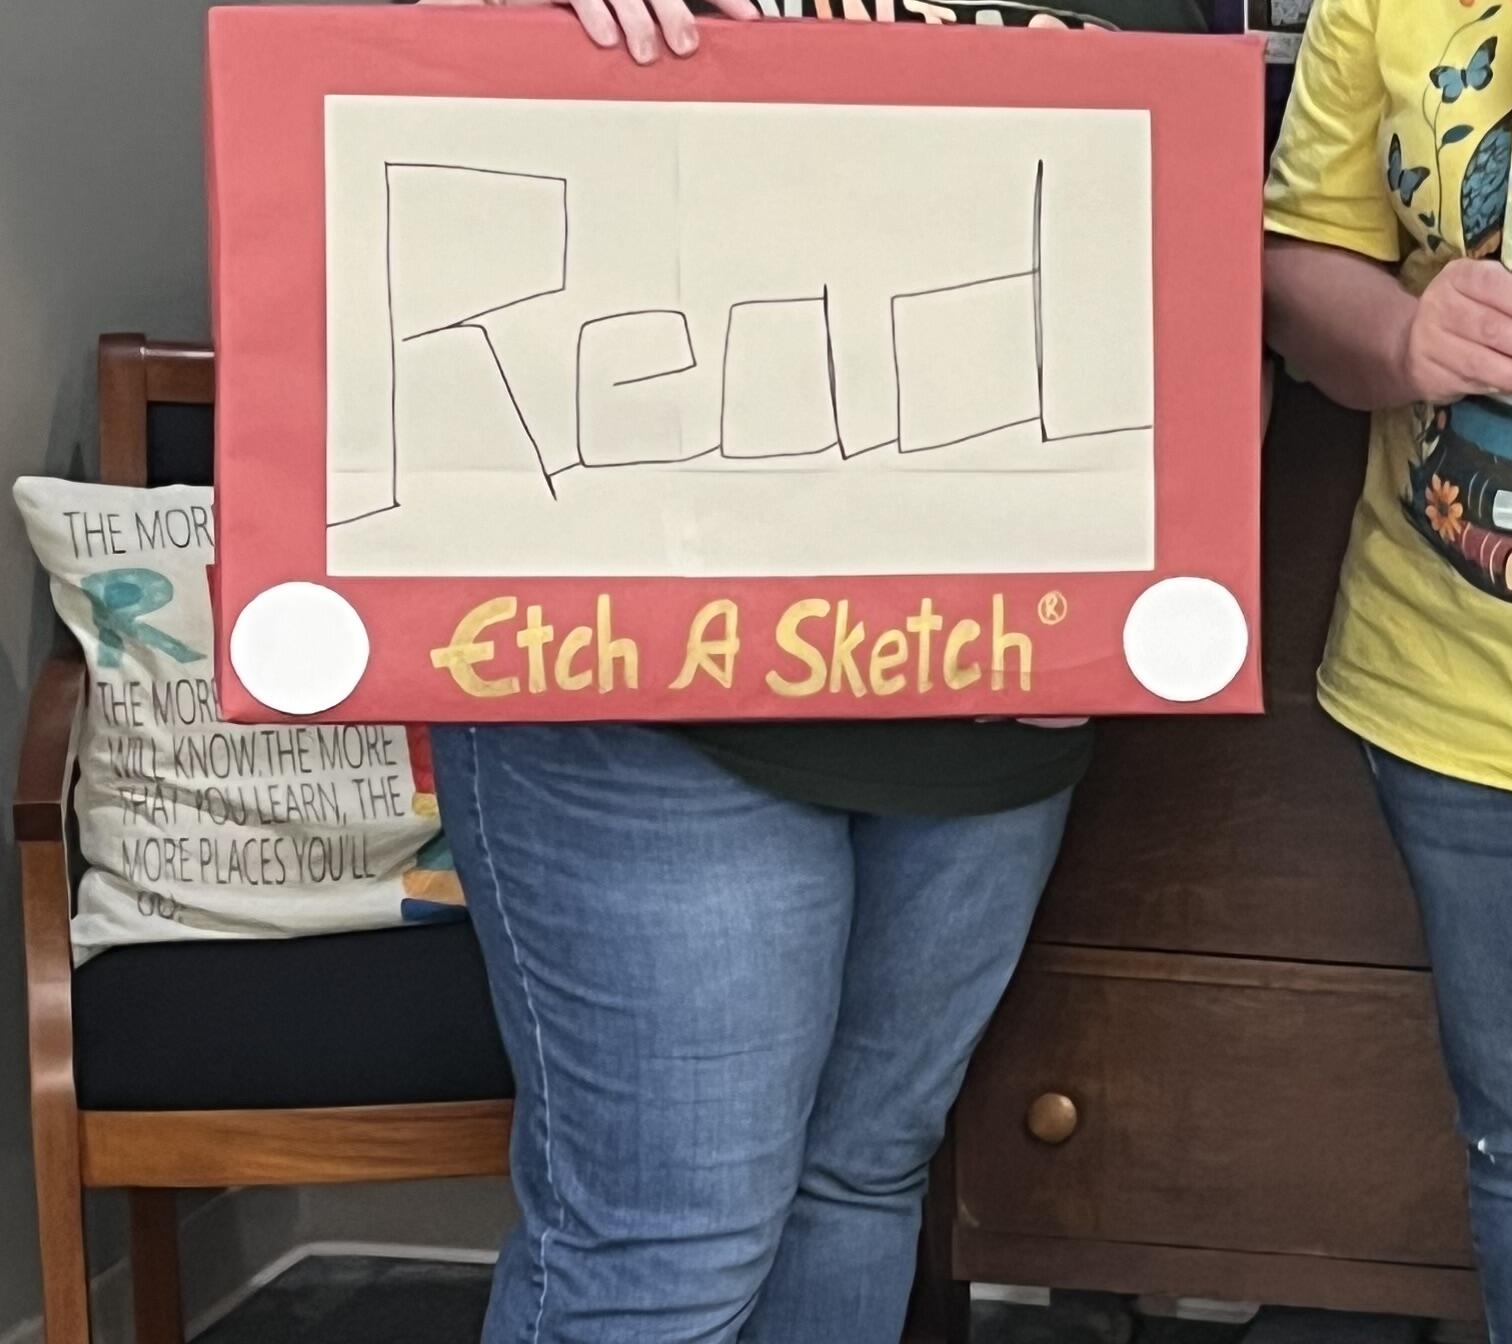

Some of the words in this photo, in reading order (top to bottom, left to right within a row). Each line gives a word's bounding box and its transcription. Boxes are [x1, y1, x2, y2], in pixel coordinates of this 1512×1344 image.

[62, 511, 127, 559] THE
[135, 505, 215, 551] MOR
[430, 593, 640, 698] Etch
[668, 598, 740, 690] A
[97, 681, 145, 728] THE
[316, 723, 398, 771] MORE
[254, 781, 348, 826] LEARN,
[352, 774, 405, 821] THE
[121, 836, 194, 883] MORE
[199, 836, 286, 886] PLACES
[290, 832, 376, 883] YOU'LL
